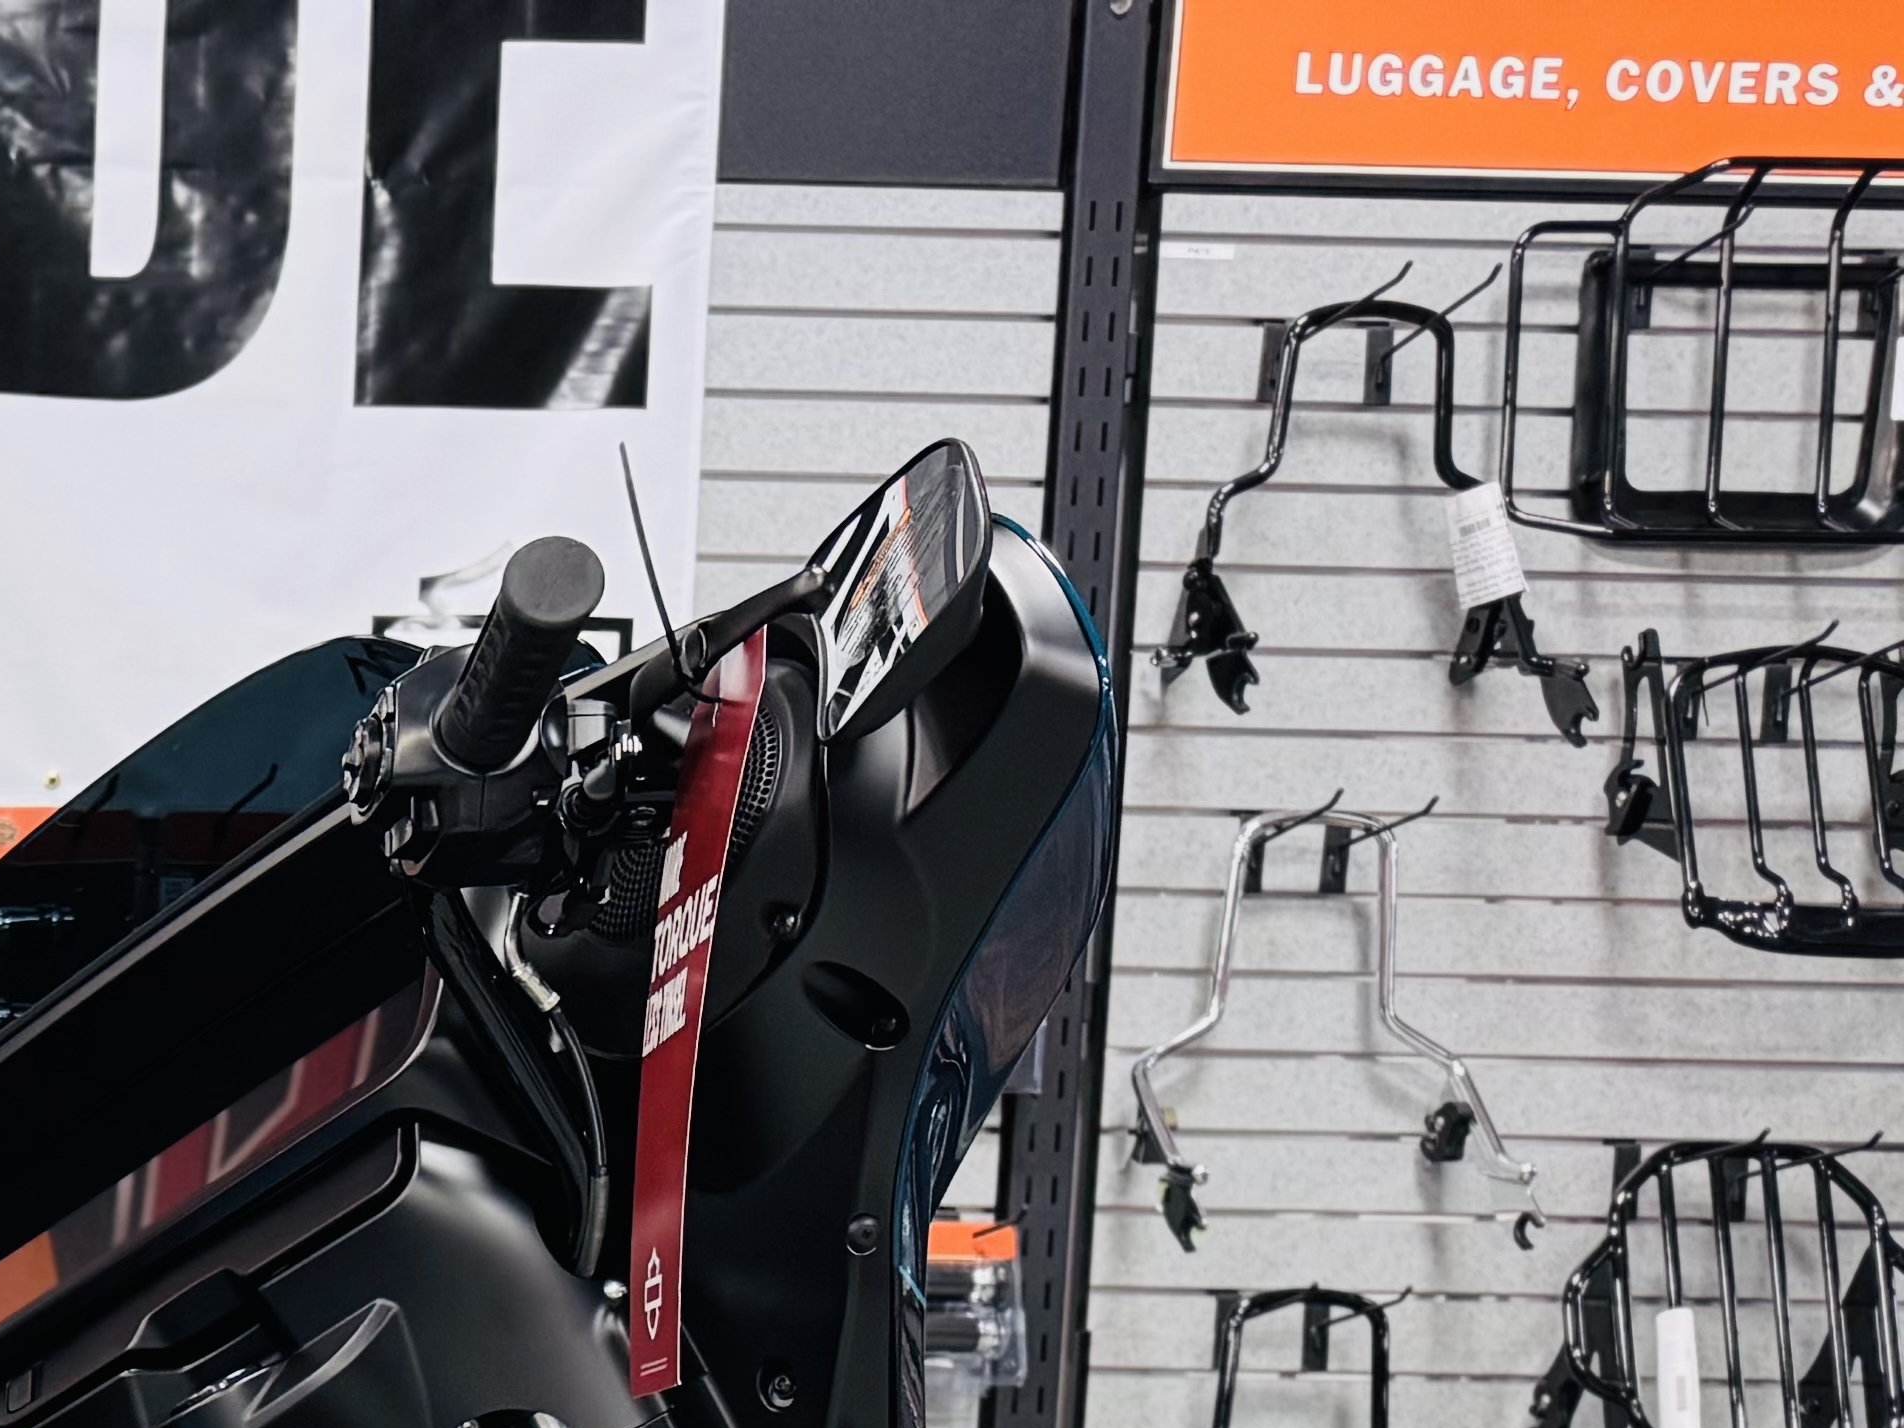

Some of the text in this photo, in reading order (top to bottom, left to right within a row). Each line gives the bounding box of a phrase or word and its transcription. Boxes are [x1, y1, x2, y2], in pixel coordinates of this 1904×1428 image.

[1295, 52, 1904, 110] LUGGAGE, COVERS &
